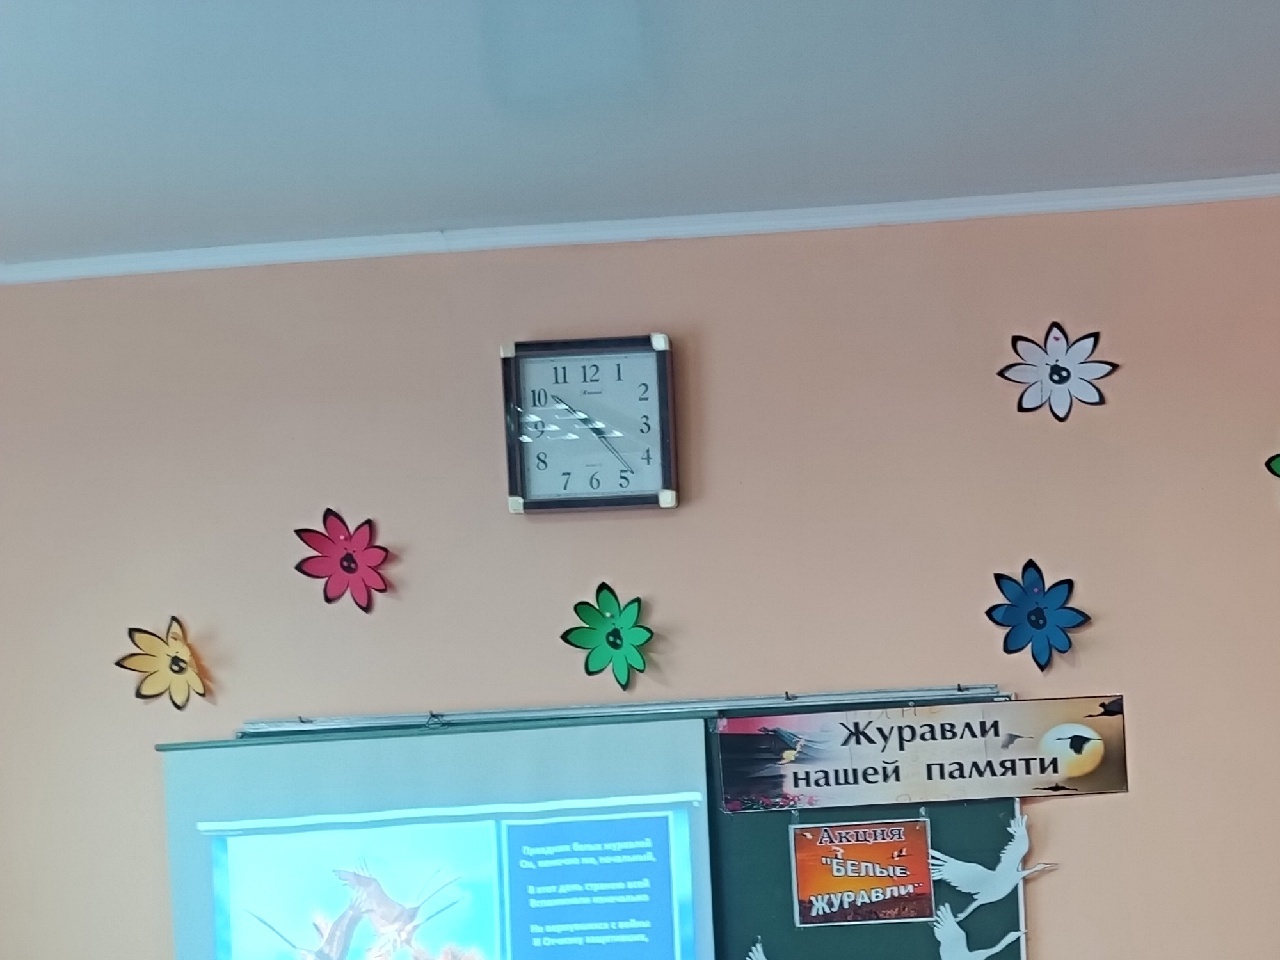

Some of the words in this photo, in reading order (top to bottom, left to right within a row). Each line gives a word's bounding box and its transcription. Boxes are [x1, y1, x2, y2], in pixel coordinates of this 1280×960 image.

[552, 366, 568, 384] 11
[581, 364, 600, 383] 12
[616, 363, 623, 381] 1
[531, 388, 548, 407] 10
[638, 383, 649, 401] 2
[534, 420, 546, 439] 9
[640, 415, 651, 434] 3
[536, 452, 548, 471] 8
[641, 447, 652, 465] 4
[561, 472, 572, 490] 7
[589, 471, 601, 490] 6
[619, 469, 630, 488] 5
[839, 720, 1001, 753] Журавли
[793, 759, 901, 789] нашей
[926, 756, 1060, 781] памяти
[817, 827, 905, 846] Акция
[821, 857, 908, 878] "БЕЛЫЕ
[809, 883, 924, 917] ЖУРАВЛИ"
